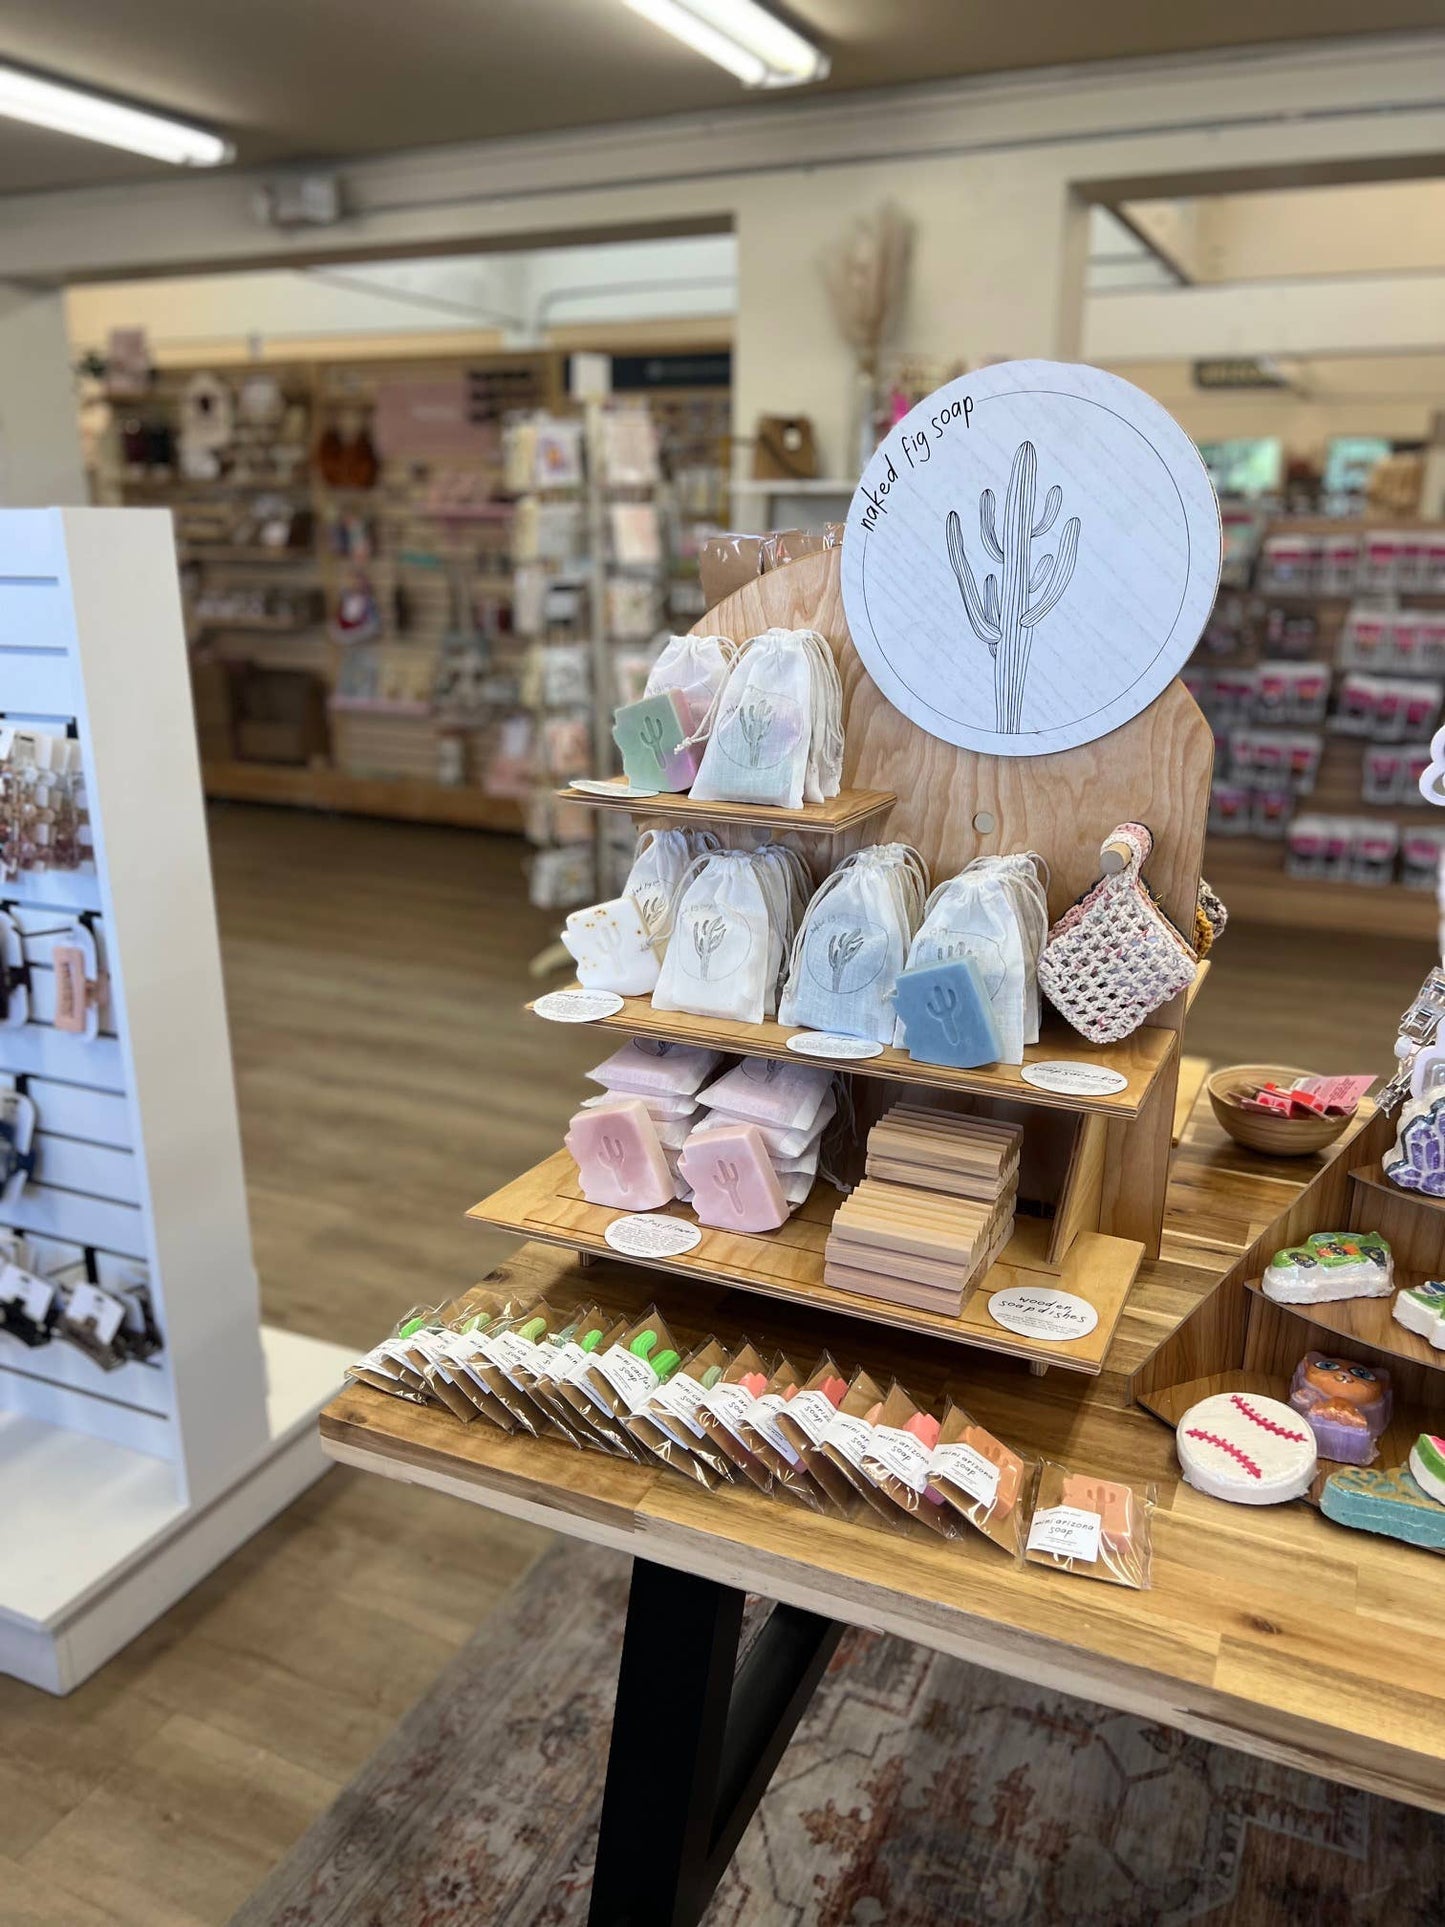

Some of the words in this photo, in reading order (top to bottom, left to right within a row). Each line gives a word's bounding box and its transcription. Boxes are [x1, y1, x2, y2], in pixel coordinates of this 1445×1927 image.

[860, 453, 899, 532] naked
[901, 431, 931, 469] fig
[931, 395, 974, 438] soap
[1019, 1296, 1073, 1310] wooden
[615, 1353, 631, 1366] mini
[630, 1365, 651, 1390] cactus
[619, 1366, 638, 1382] soap
[680, 1395, 697, 1406] soa
[728, 1401, 744, 1418] soa
[804, 1406, 823, 1423] soap
[877, 1434, 898, 1443] mini
[890, 1445, 912, 1462] soap
[953, 1461, 976, 1476] soap
[961, 1456, 994, 1480] arizona
[1033, 1518, 1054, 1526] mini
[1055, 1519, 1094, 1530] arizona
[1048, 1526, 1074, 1538] soap
